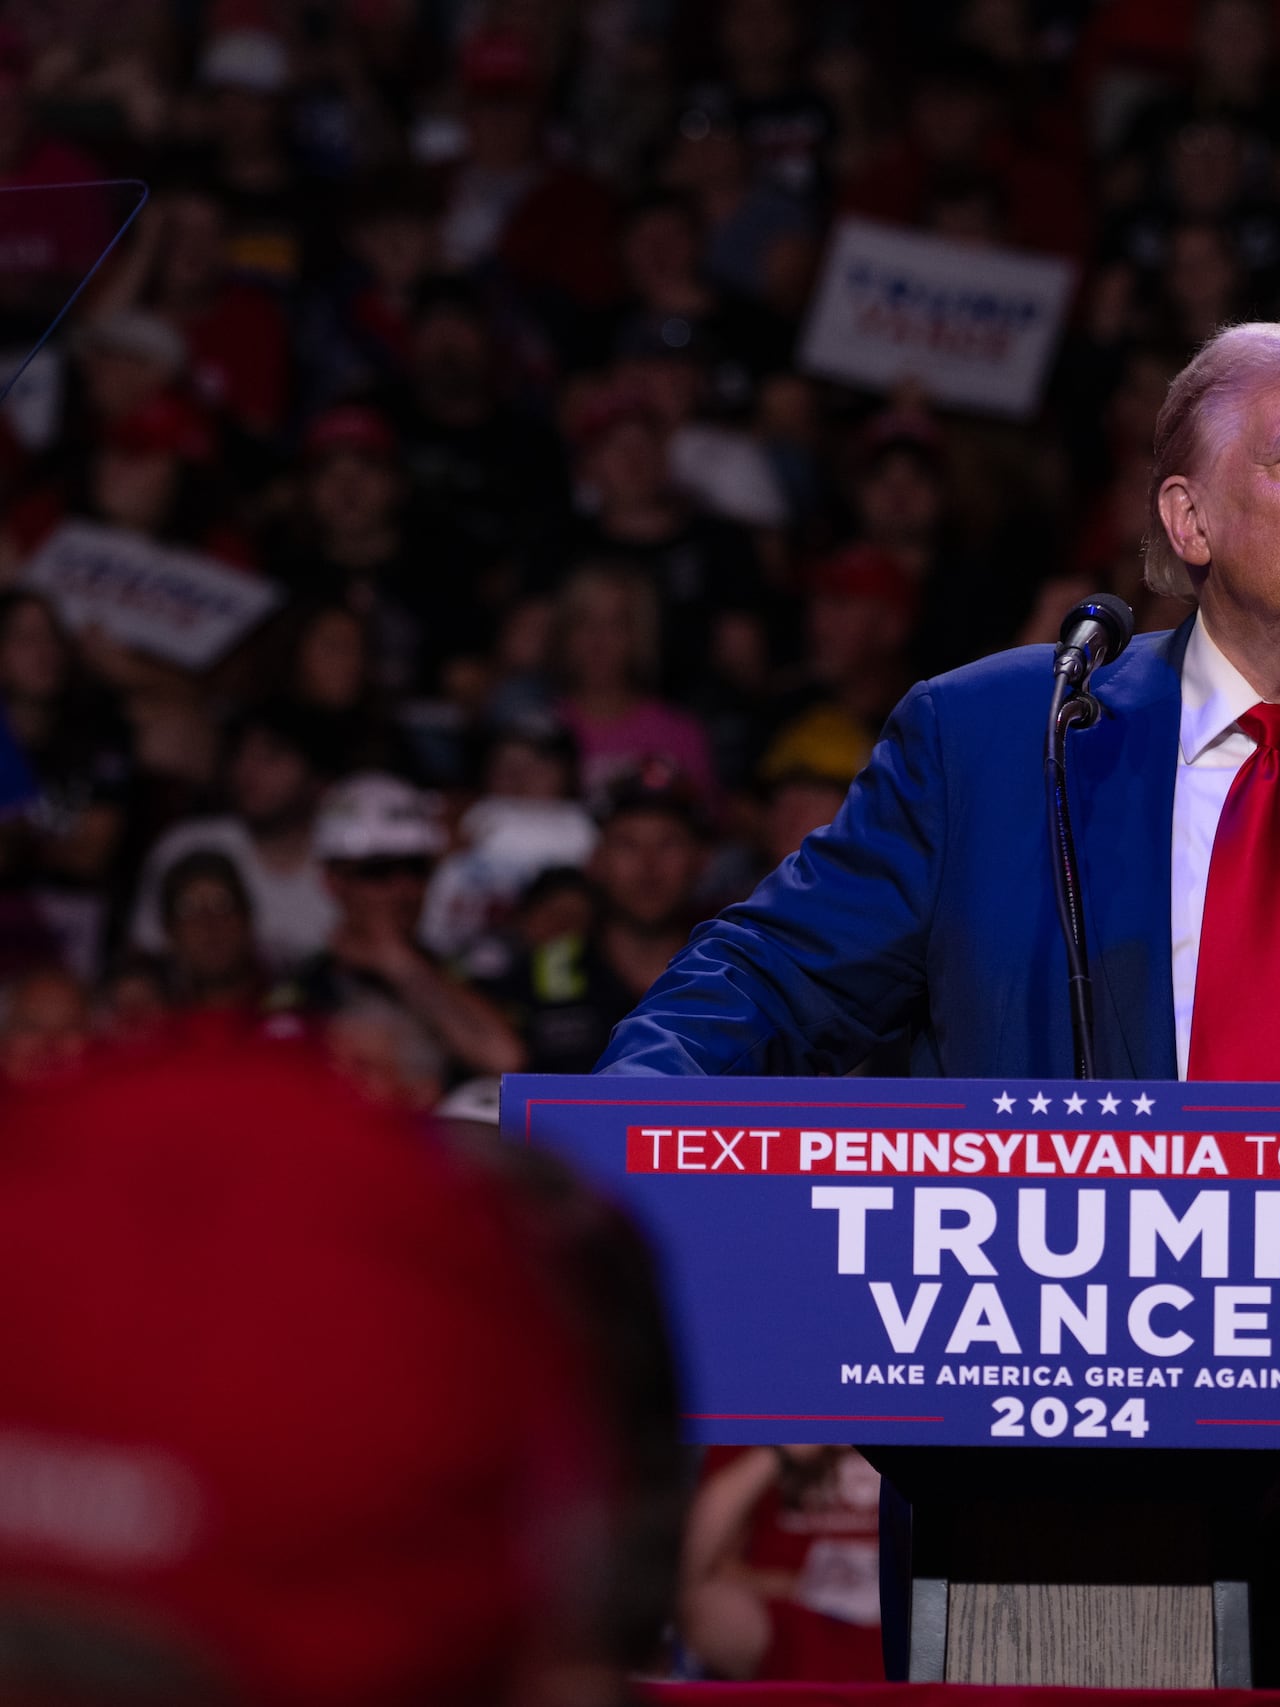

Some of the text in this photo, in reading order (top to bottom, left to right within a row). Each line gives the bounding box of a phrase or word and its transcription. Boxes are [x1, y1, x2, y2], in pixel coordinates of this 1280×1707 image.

[640, 1128, 781, 1171] TEXT
[799, 1131, 1229, 1175] PENNSYLVANIA
[867, 1281, 1273, 1358] VANCE
[840, 1364, 925, 1385] MAKE
[935, 1365, 1074, 1387] AMERICA
[1084, 1366, 1184, 1388] GREAT
[990, 1396, 1150, 1438] 2024
